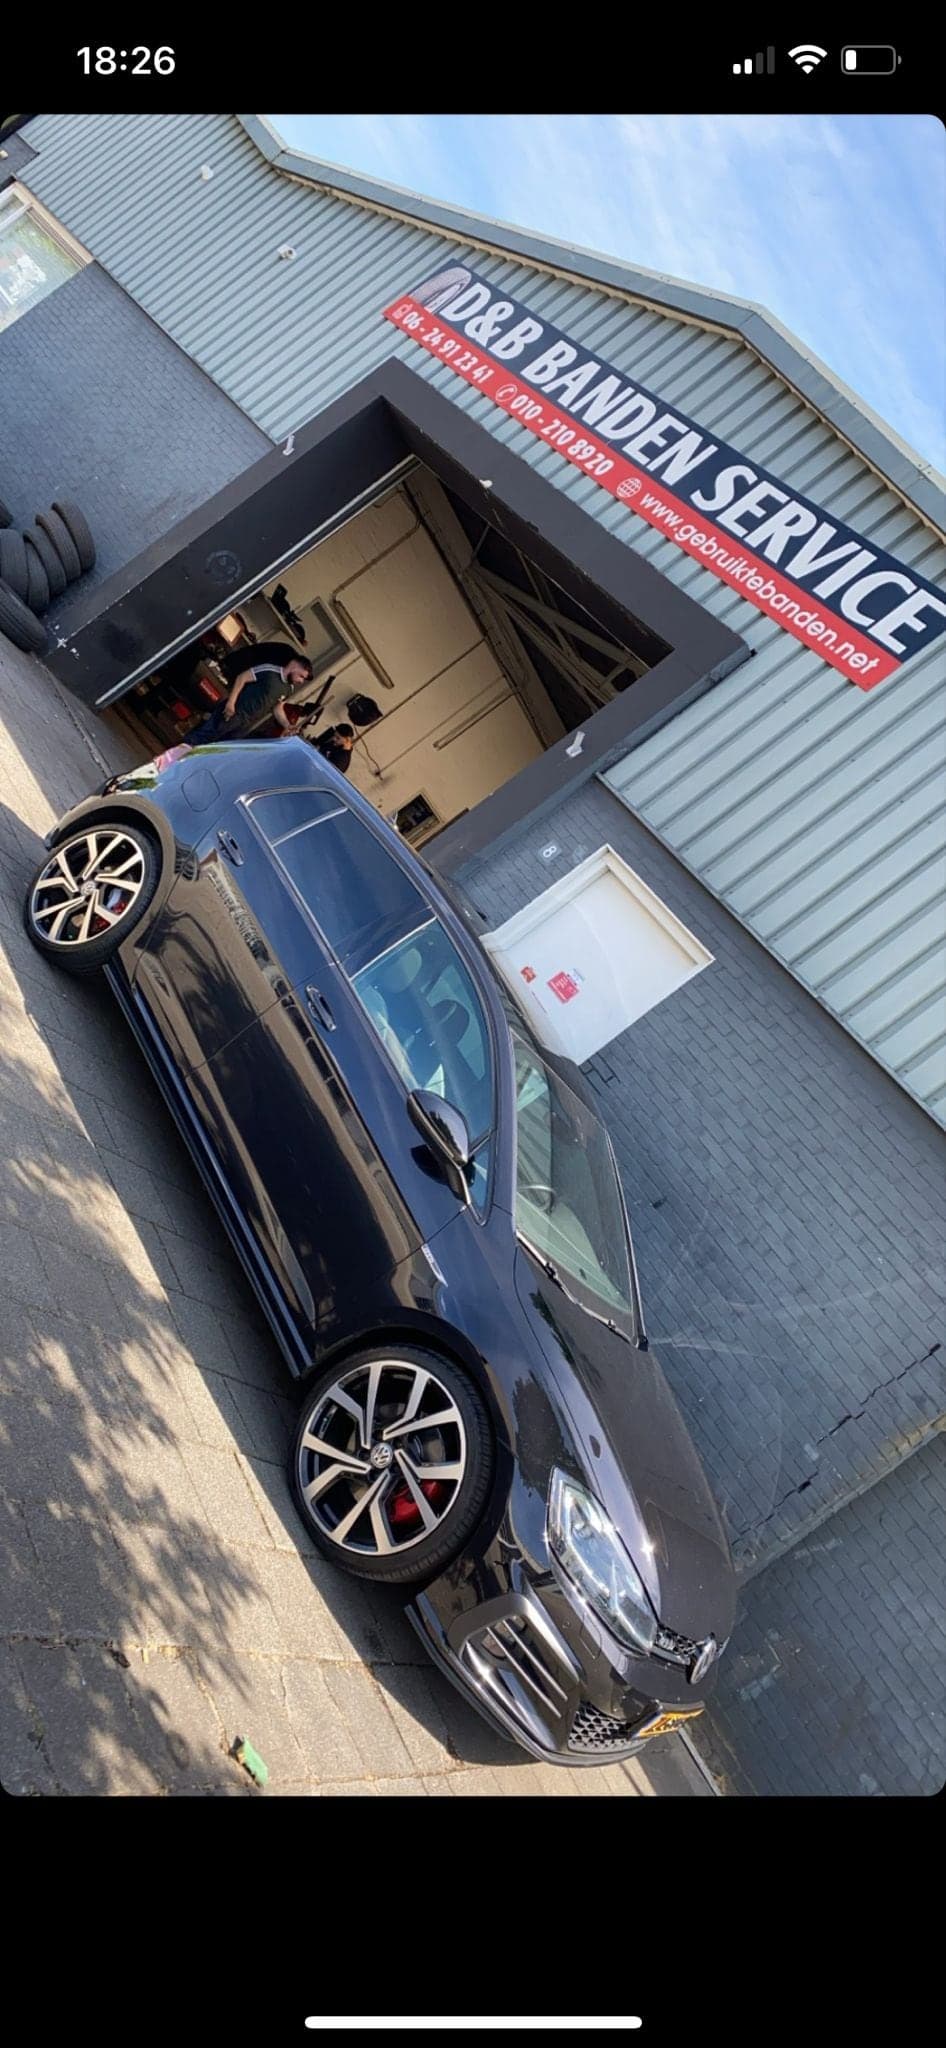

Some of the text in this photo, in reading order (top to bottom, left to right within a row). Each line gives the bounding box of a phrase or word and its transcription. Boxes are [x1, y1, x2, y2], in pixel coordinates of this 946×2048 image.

[402, 311, 424, 330] 06
[422, 327, 446, 346] 24
[438, 339, 462, 359] 91
[453, 351, 478, 372] 23
[472, 364, 494, 384] 41
[510, 394, 543, 421] 010
[540, 418, 576, 446] 210
[567, 438, 615, 476] 8920
[639, 492, 881, 674] www.gebruiktebanden.net
[439, 282, 946, 654] D&B BANDEN SERVICE
[542, 845, 558, 858] 8
